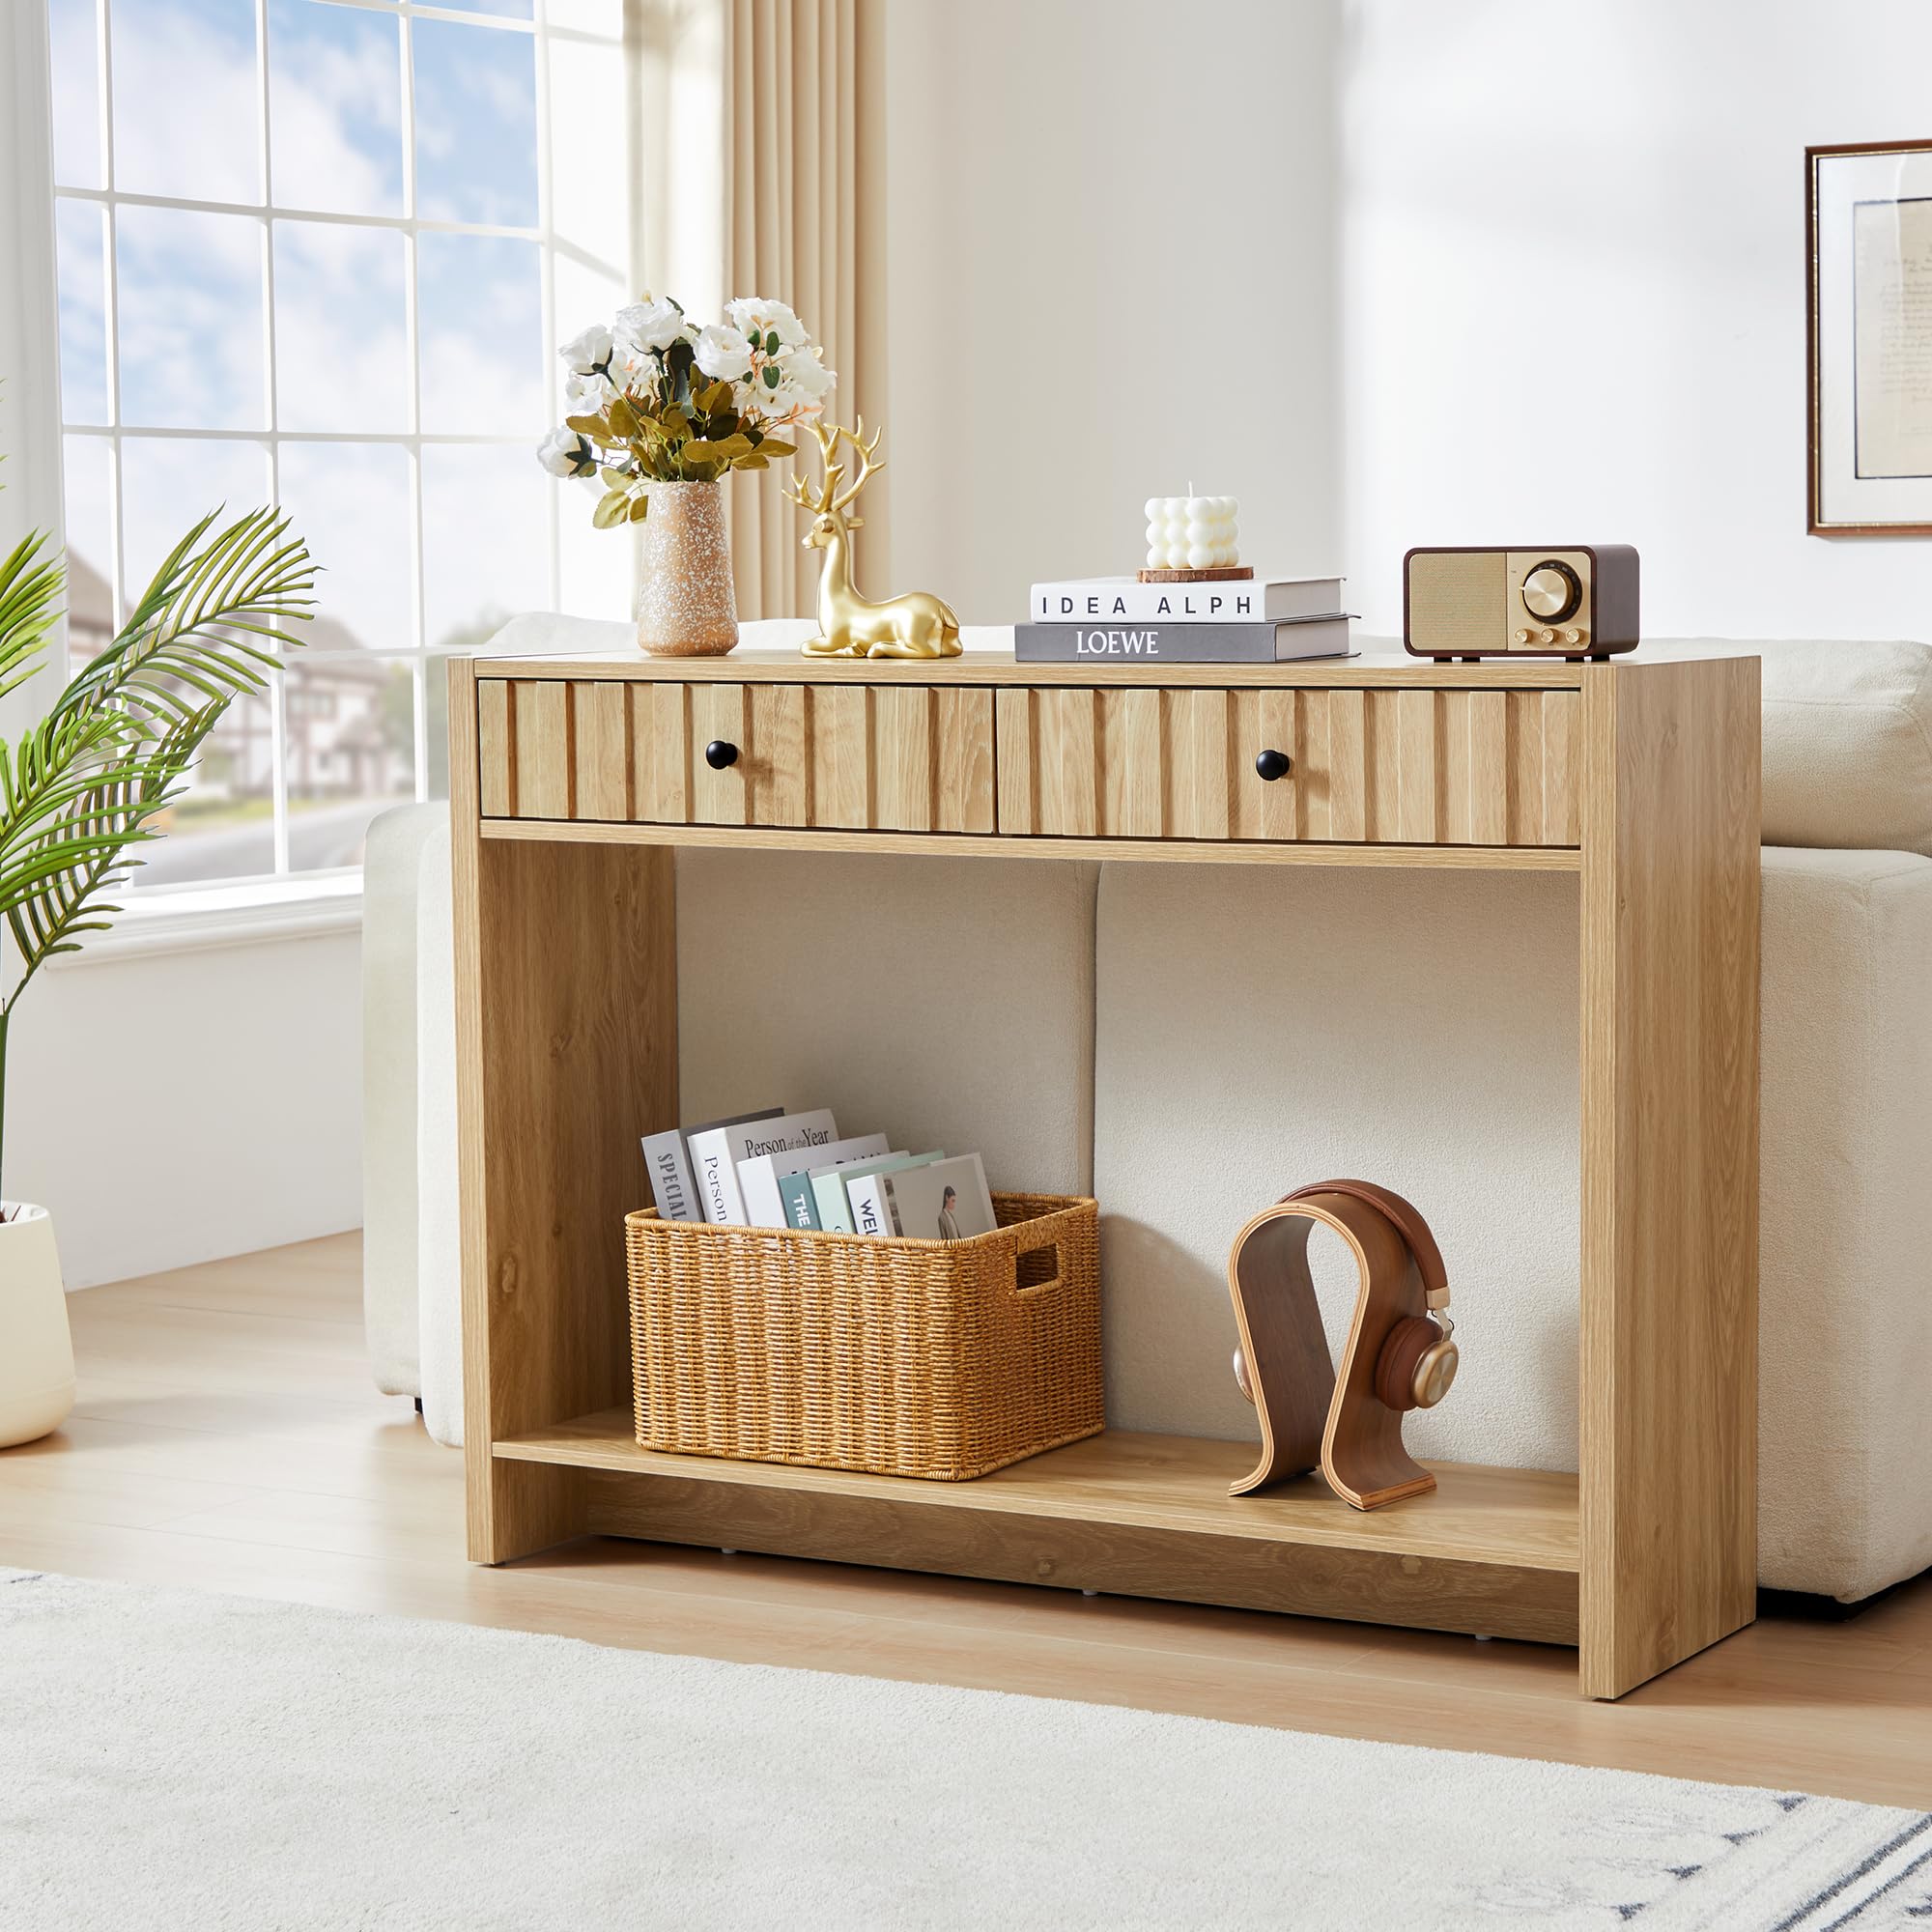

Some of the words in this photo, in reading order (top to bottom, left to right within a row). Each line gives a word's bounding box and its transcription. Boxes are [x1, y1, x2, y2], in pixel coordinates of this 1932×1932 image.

[1042, 596, 1126, 614] IDEA
[1157, 596, 1251, 614] ALPH
[1076, 630, 1159, 654] LOEWE
[744, 1137, 787, 1159] Person
[802, 1127, 829, 1148] Year
[657, 1152, 687, 1221] SPECIAL
[704, 1156, 727, 1222] Person
[793, 1193, 811, 1228] THE
